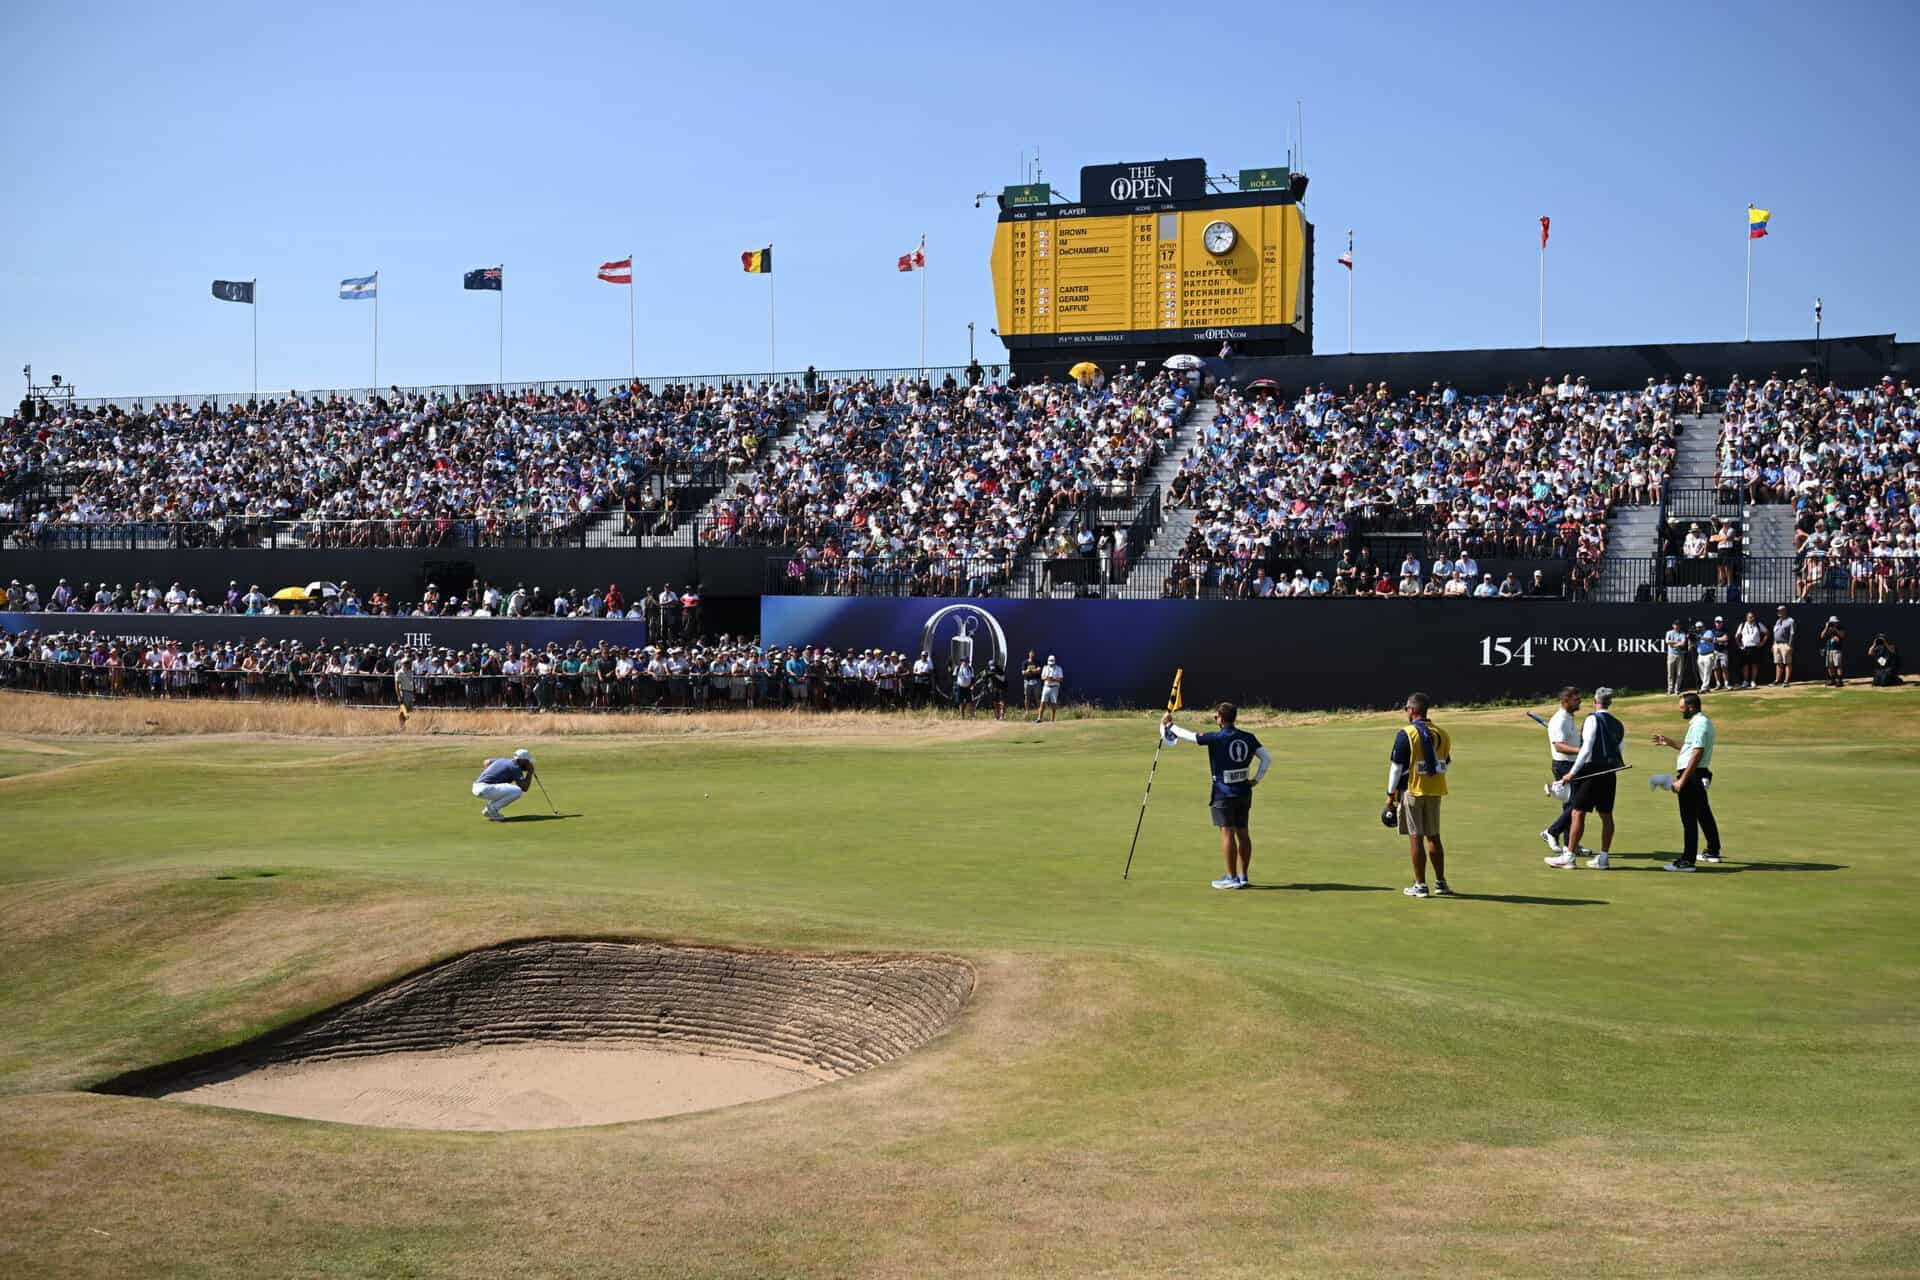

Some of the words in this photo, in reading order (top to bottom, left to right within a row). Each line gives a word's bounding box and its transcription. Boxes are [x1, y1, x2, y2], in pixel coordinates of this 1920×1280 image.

[1128, 166, 1156, 178] THE
[1110, 176, 1173, 200] OPEN
[1250, 180, 1279, 188] ROLEX
[1014, 195, 1040, 203] ROLEX
[1059, 207, 1087, 216] PLAYER
[1059, 228, 1087, 237] BROWN
[1016, 250, 1026, 258] 17
[1059, 246, 1109, 256] DeCHAMBEAU
[1162, 250, 1175, 261] 17
[1183, 279, 1220, 287] HATTON
[1059, 285, 1089, 293] CANTER
[1058, 295, 1090, 303] GERARD
[1183, 299, 1220, 307] SPIETH
[1059, 304, 1089, 312] DAFFUE
[1183, 307, 1238, 317] FLEETWOOD
[404, 632, 432, 647] THE
[1480, 636, 1548, 666] 154TH
[1553, 637, 1612, 653] ROYAL
[1617, 638, 1666, 653] BIRK
